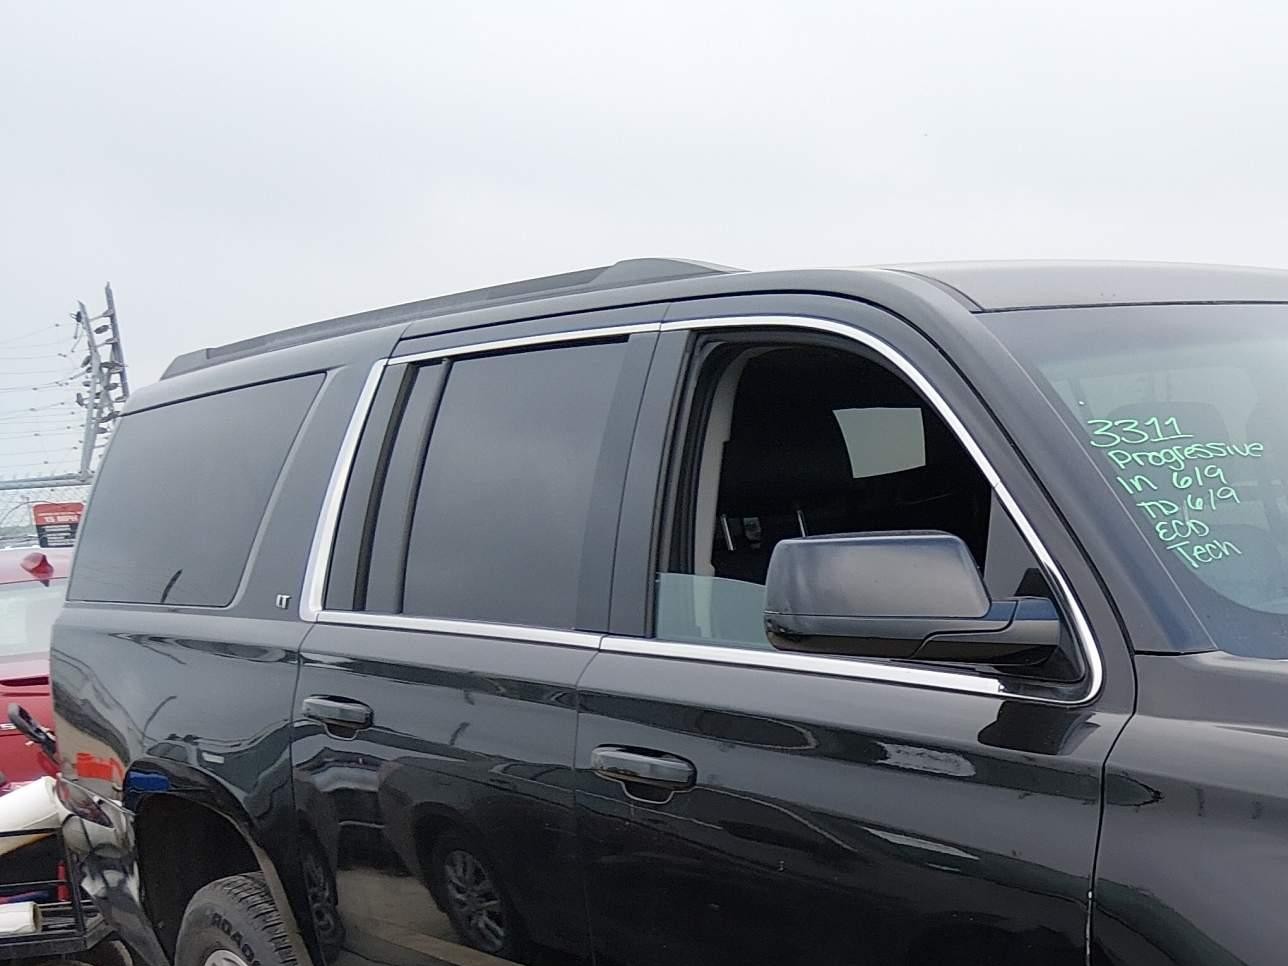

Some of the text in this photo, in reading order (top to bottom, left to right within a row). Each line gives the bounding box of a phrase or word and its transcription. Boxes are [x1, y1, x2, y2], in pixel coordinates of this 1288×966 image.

[1087, 416, 1194, 447] 3311
[1172, 464, 1228, 490] 6/9
[1187, 486, 1241, 511] 6/9
[1166, 539, 1242, 569] Tech
[275, 593, 291, 609] LT
